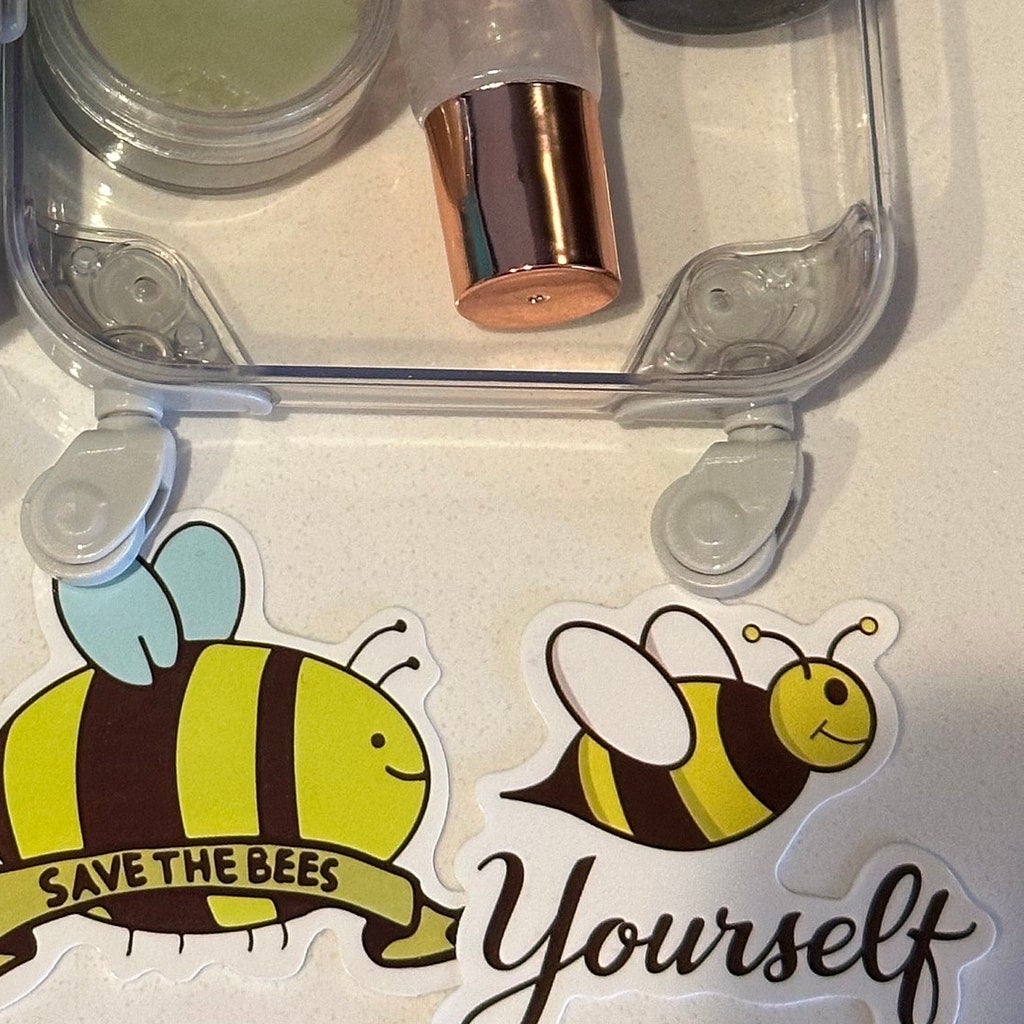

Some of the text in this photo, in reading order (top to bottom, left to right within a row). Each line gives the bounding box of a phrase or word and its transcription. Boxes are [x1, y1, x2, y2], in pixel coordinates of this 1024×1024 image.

[38, 847, 340, 908] SAVE THE BEES
[461, 850, 977, 1024] Yourself
